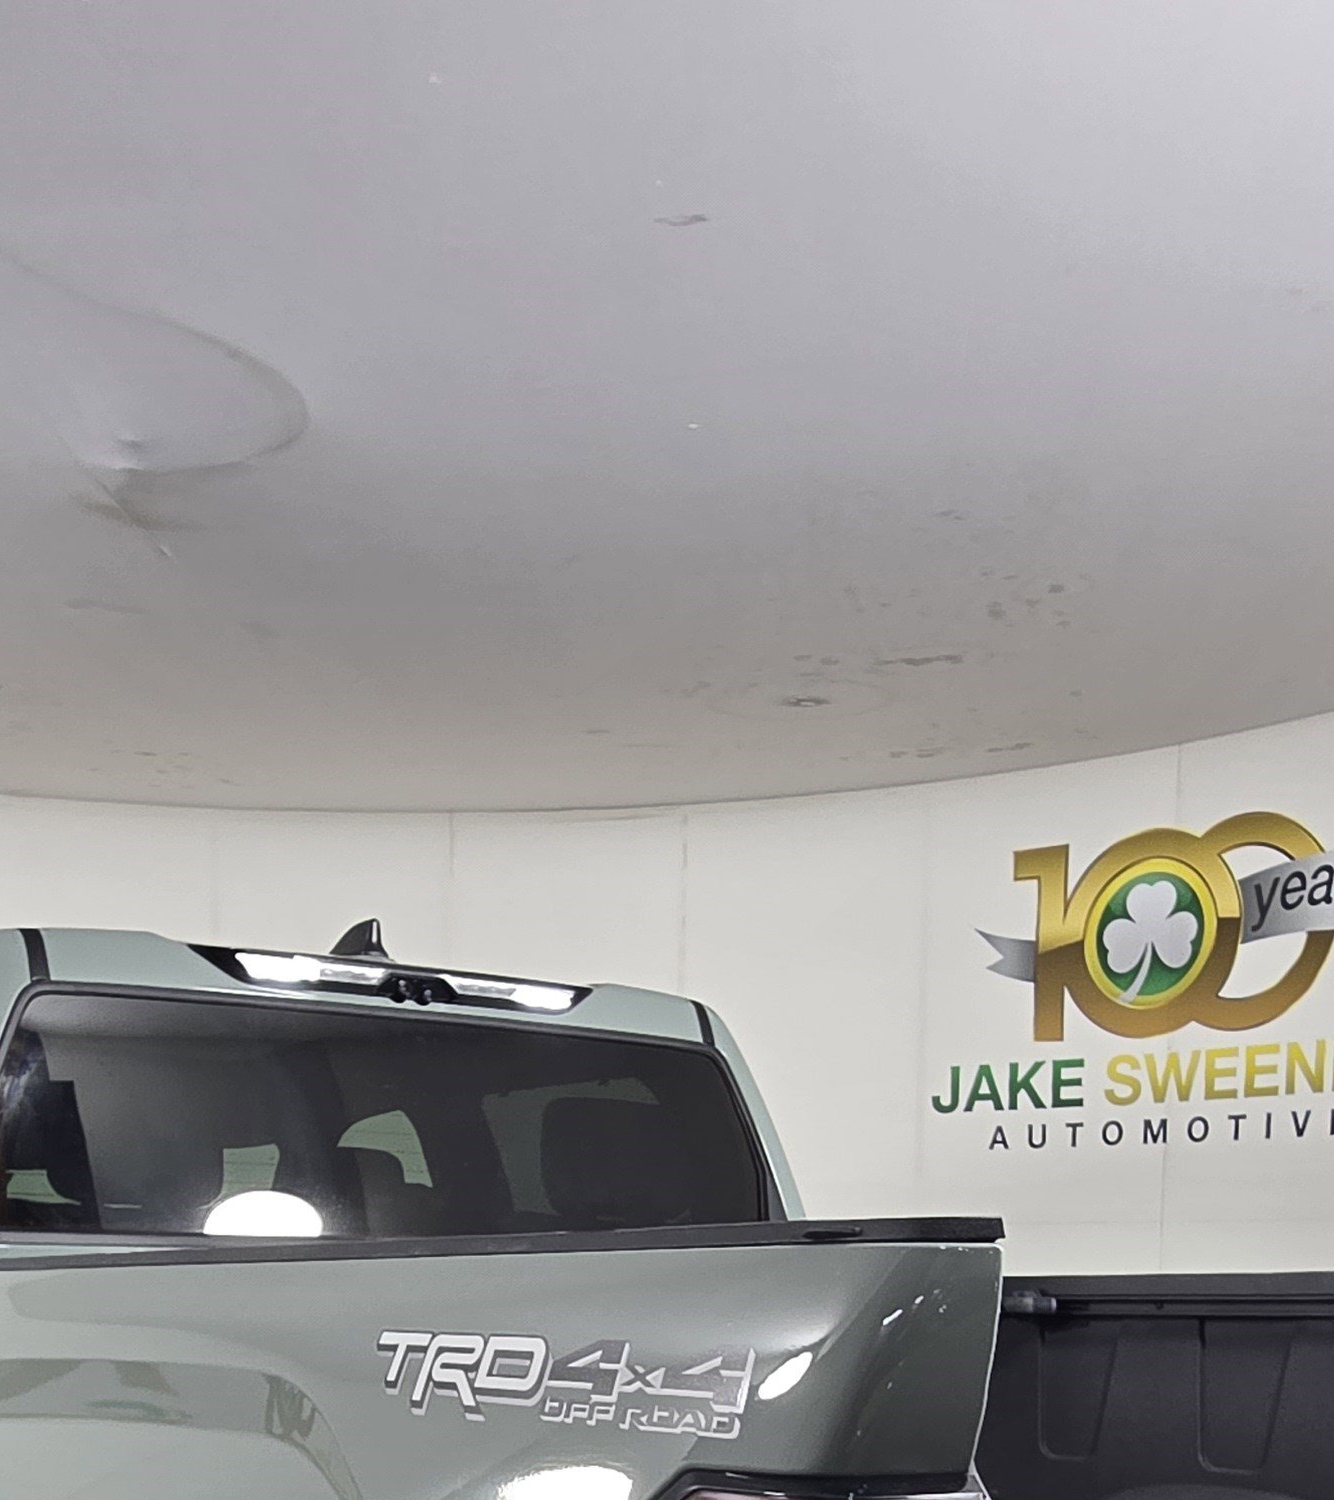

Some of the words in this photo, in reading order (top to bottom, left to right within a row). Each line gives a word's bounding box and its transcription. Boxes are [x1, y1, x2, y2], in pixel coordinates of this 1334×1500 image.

[931, 1058, 1085, 1114] JAKE
[376, 1329, 551, 1421] TRD
[540, 1397, 616, 1426] OFF
[618, 1405, 741, 1440] ROAD
